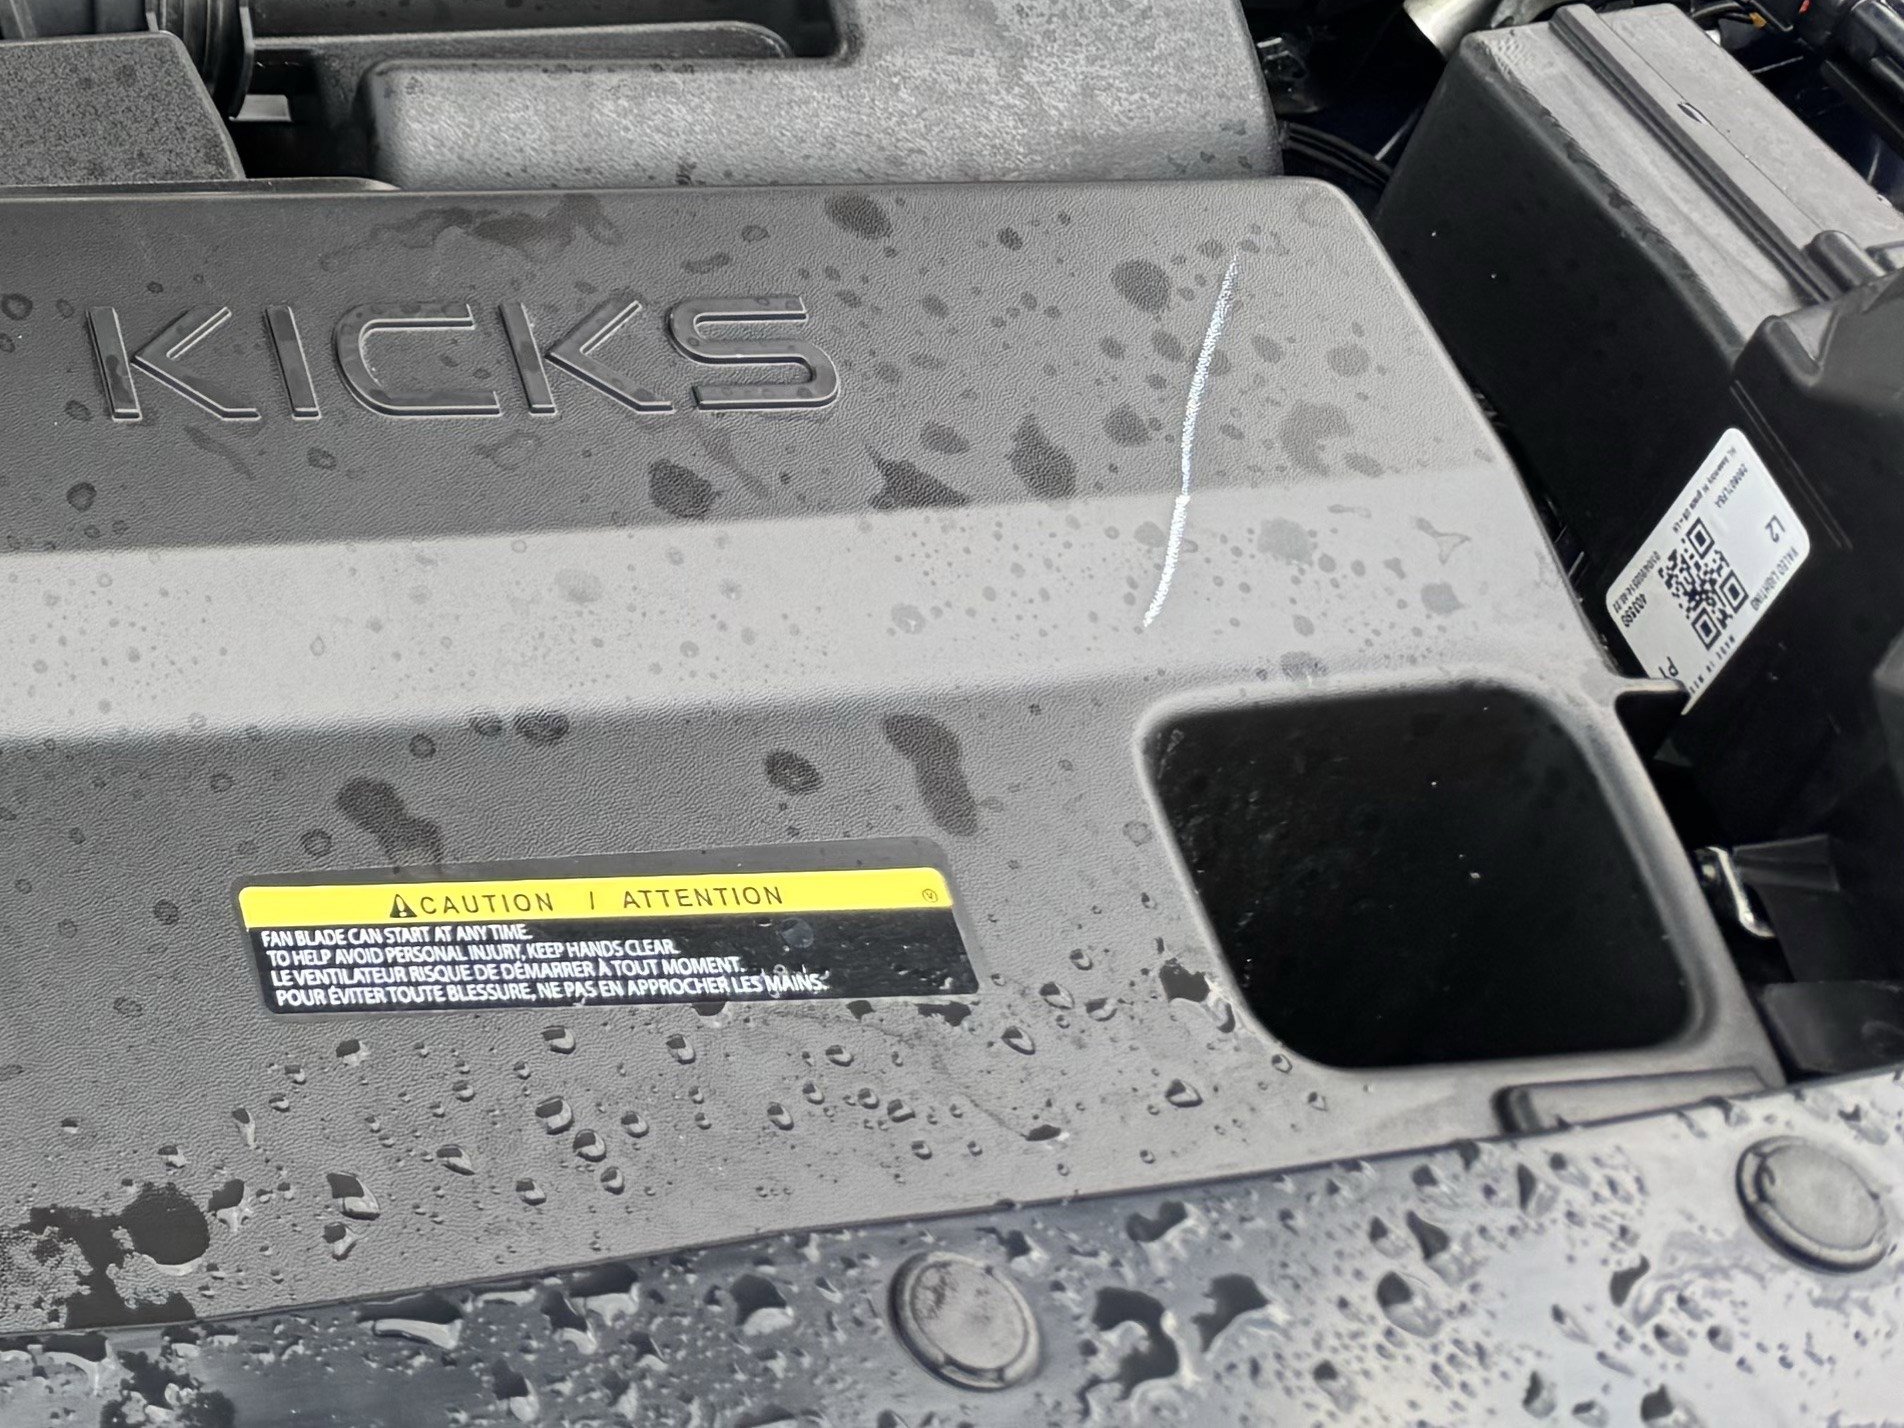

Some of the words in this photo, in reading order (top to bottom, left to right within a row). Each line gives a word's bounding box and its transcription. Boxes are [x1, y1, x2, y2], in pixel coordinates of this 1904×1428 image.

[85, 295, 840, 423] KICKS
[1763, 512, 1786, 545] L2
[420, 892, 553, 914] CAUTION
[623, 886, 783, 910] ATTENTION
[261, 929, 293, 948] FAN
[294, 927, 345, 947] BLADE
[348, 927, 383, 945] CAN
[385, 925, 432, 944] START
[434, 925, 454, 942] AT
[456, 924, 490, 941] ANY
[266, 949, 290, 967] TO
[293, 948, 332, 966] HELP
[335, 946, 385, 965] AVOID
[387, 944, 468, 964] PERSONAL
[469, 943, 526, 963] INJURY,
[528, 941, 565, 960] KEEP
[567, 939, 624, 958] HANDS
[626, 938, 682, 956] CLEAR.
[271, 968, 293, 986] LE
[293, 965, 408, 985] VENTILATEUR
[410, 964, 472, 984] RISQUE
[474, 963, 500, 981] DE
[502, 959, 595, 981] DÉMARRER
[598, 956, 613, 976] À
[613, 958, 660, 977] TOUT
[662, 956, 747, 975] MOMENT.
[276, 988, 326, 1007] POUR
[329, 985, 392, 1005] ÉVITER
[392, 985, 445, 1005] TOUTE
[447, 982, 536, 1002] BLESSURE,
[538, 982, 565, 999] NE
[566, 980, 596, 999] PAS
[599, 979, 623, 997] EN
[627, 976, 729, 996] APPROCHER
[733, 974, 763, 993] LES
